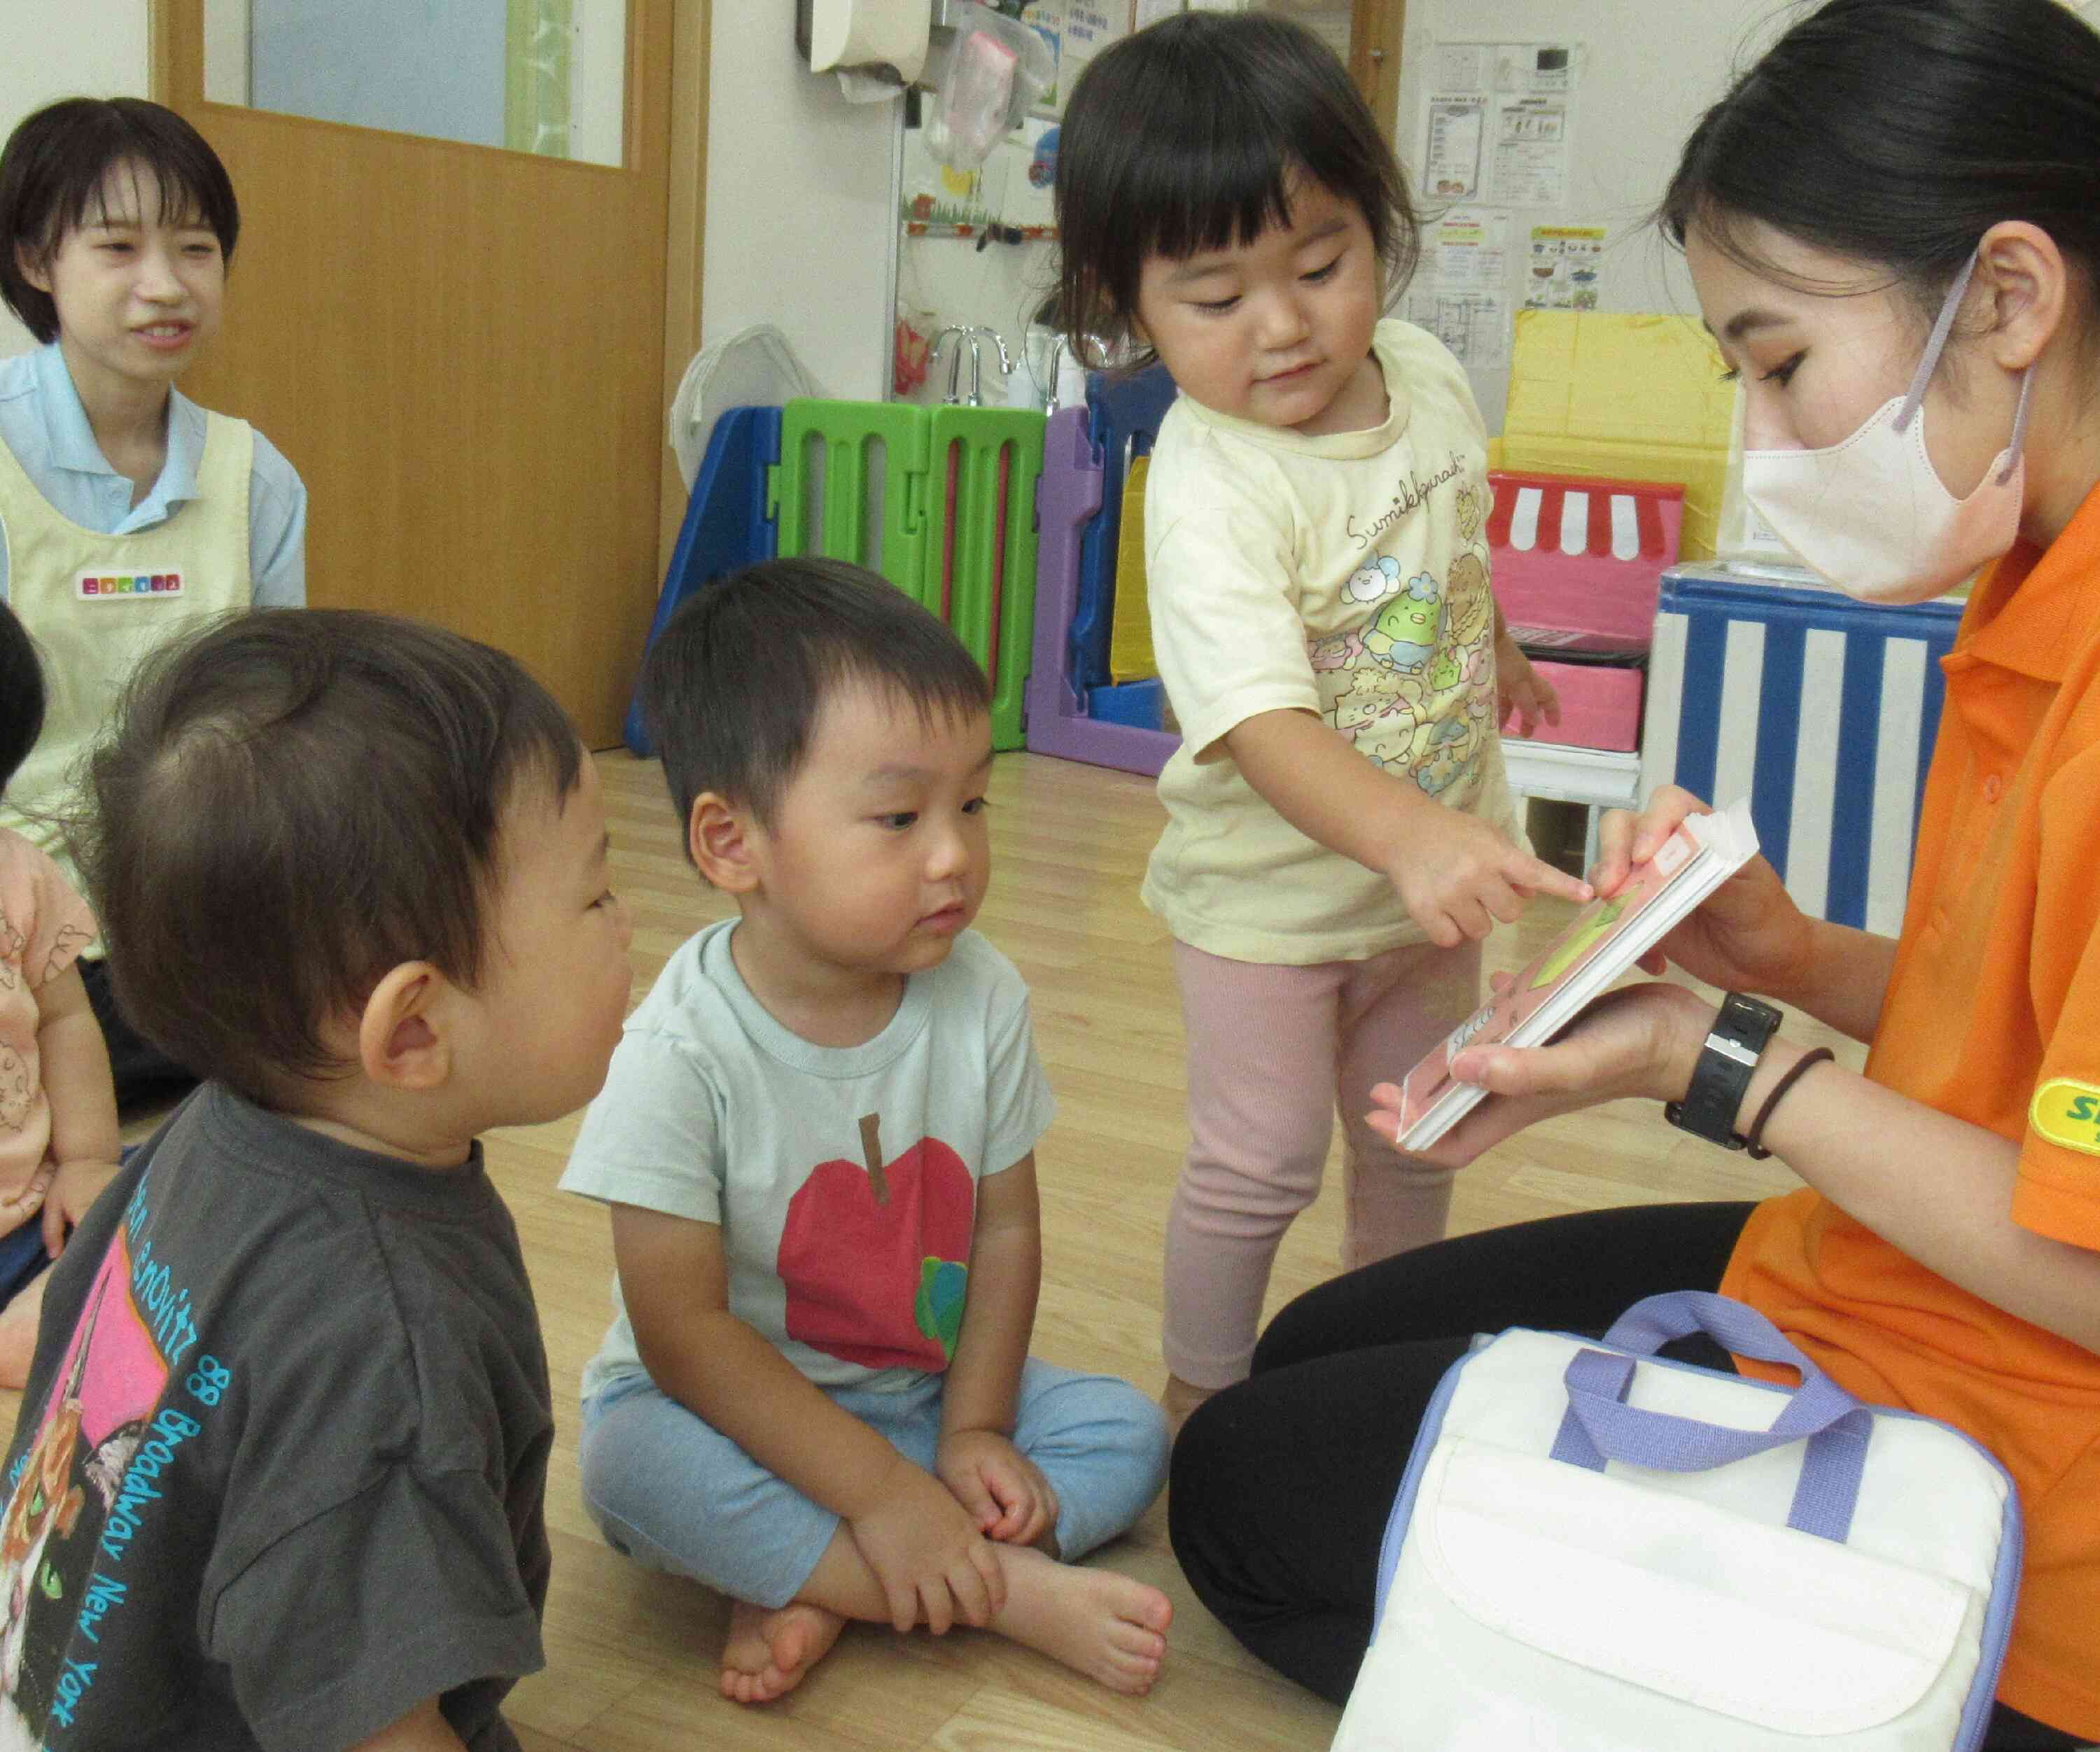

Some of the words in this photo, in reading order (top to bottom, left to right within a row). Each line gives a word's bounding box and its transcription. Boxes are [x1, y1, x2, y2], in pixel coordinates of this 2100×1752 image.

[185, 1354, 232, 1407] 88
[100, 1408, 202, 1563] Broadway
[78, 1572, 128, 1644] New
[50, 1656, 99, 1728] York
